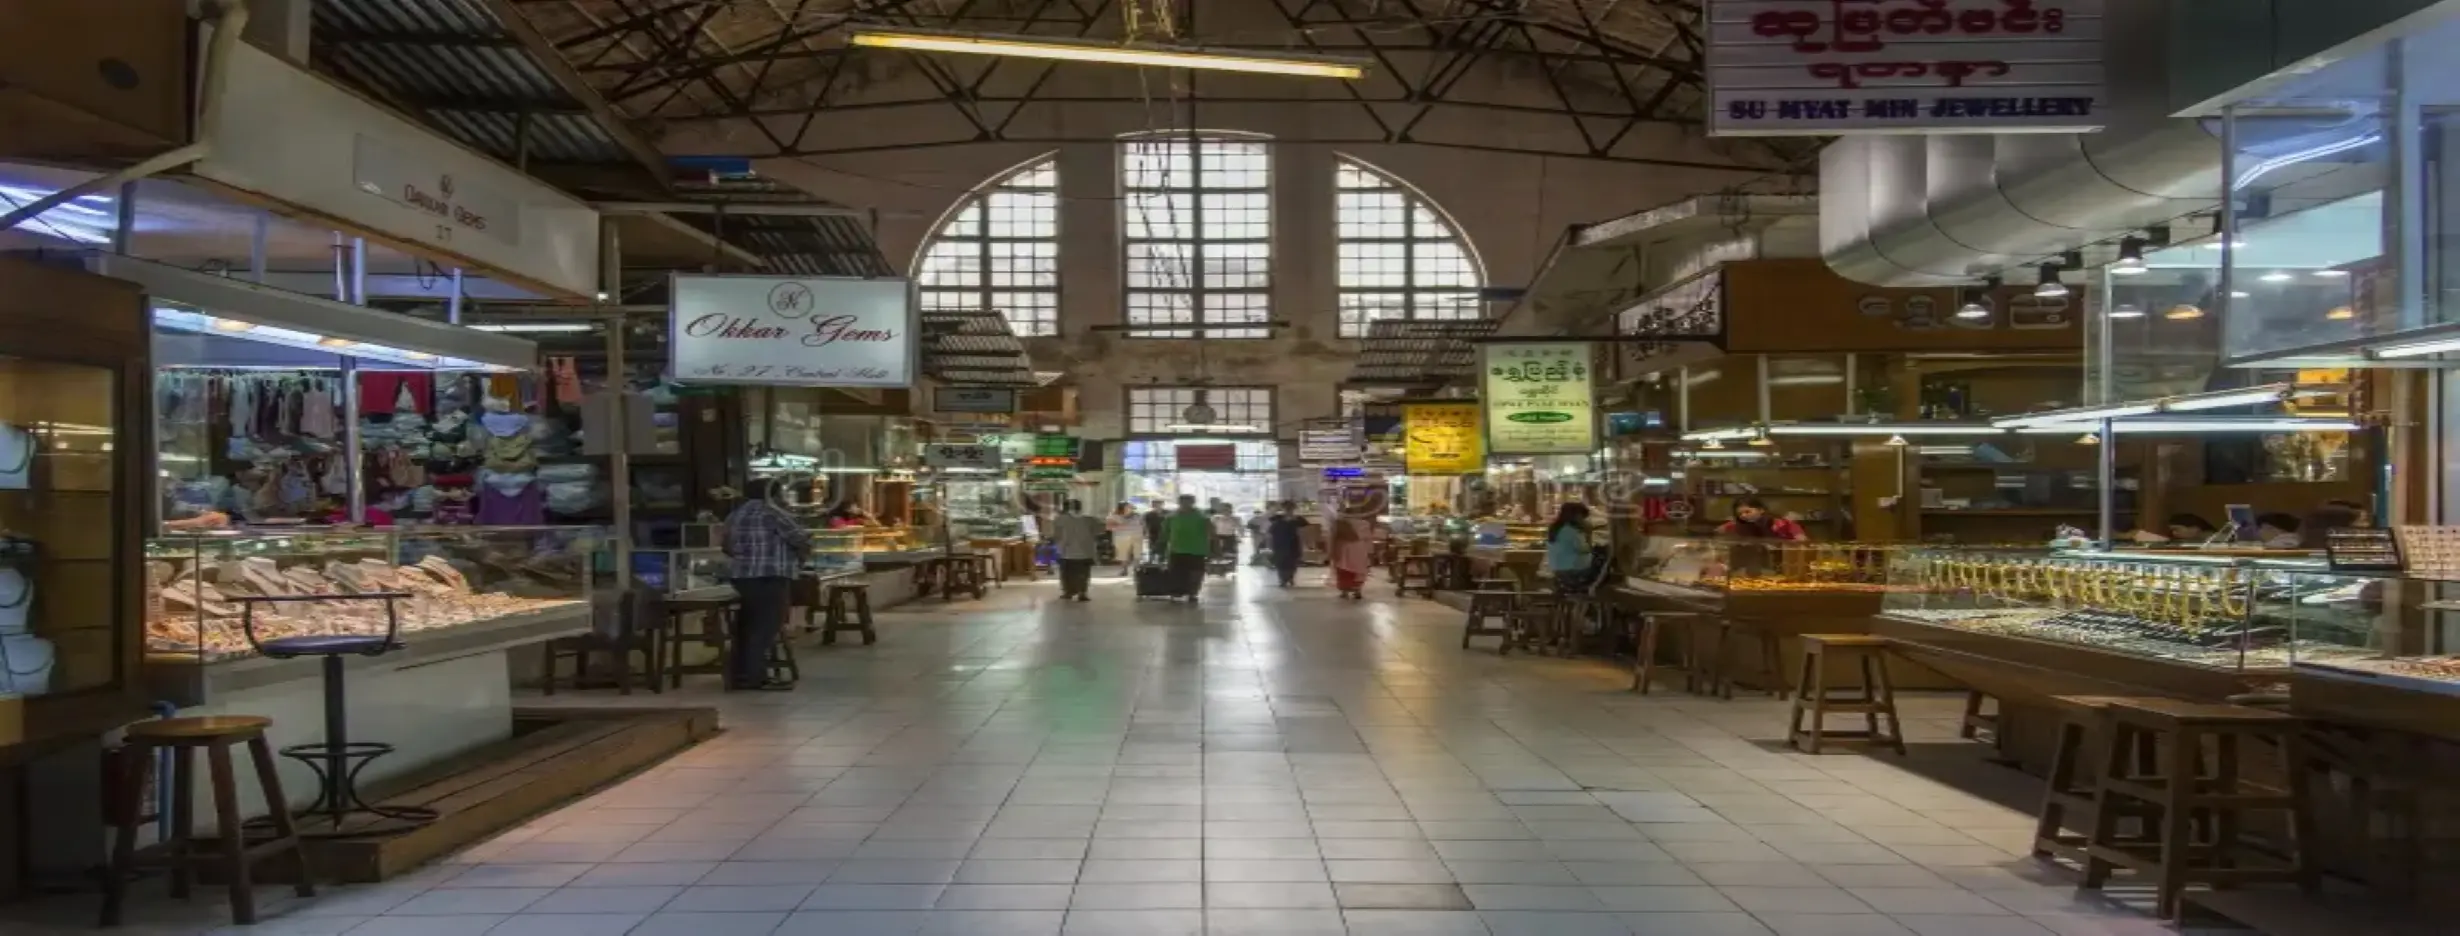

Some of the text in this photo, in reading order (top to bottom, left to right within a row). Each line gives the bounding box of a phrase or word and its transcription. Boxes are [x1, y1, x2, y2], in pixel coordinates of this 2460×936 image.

[1729, 97, 2094, 119] SU MYAT MIN JEWELLERY
[684, 312, 899, 347] Okkar Gems
